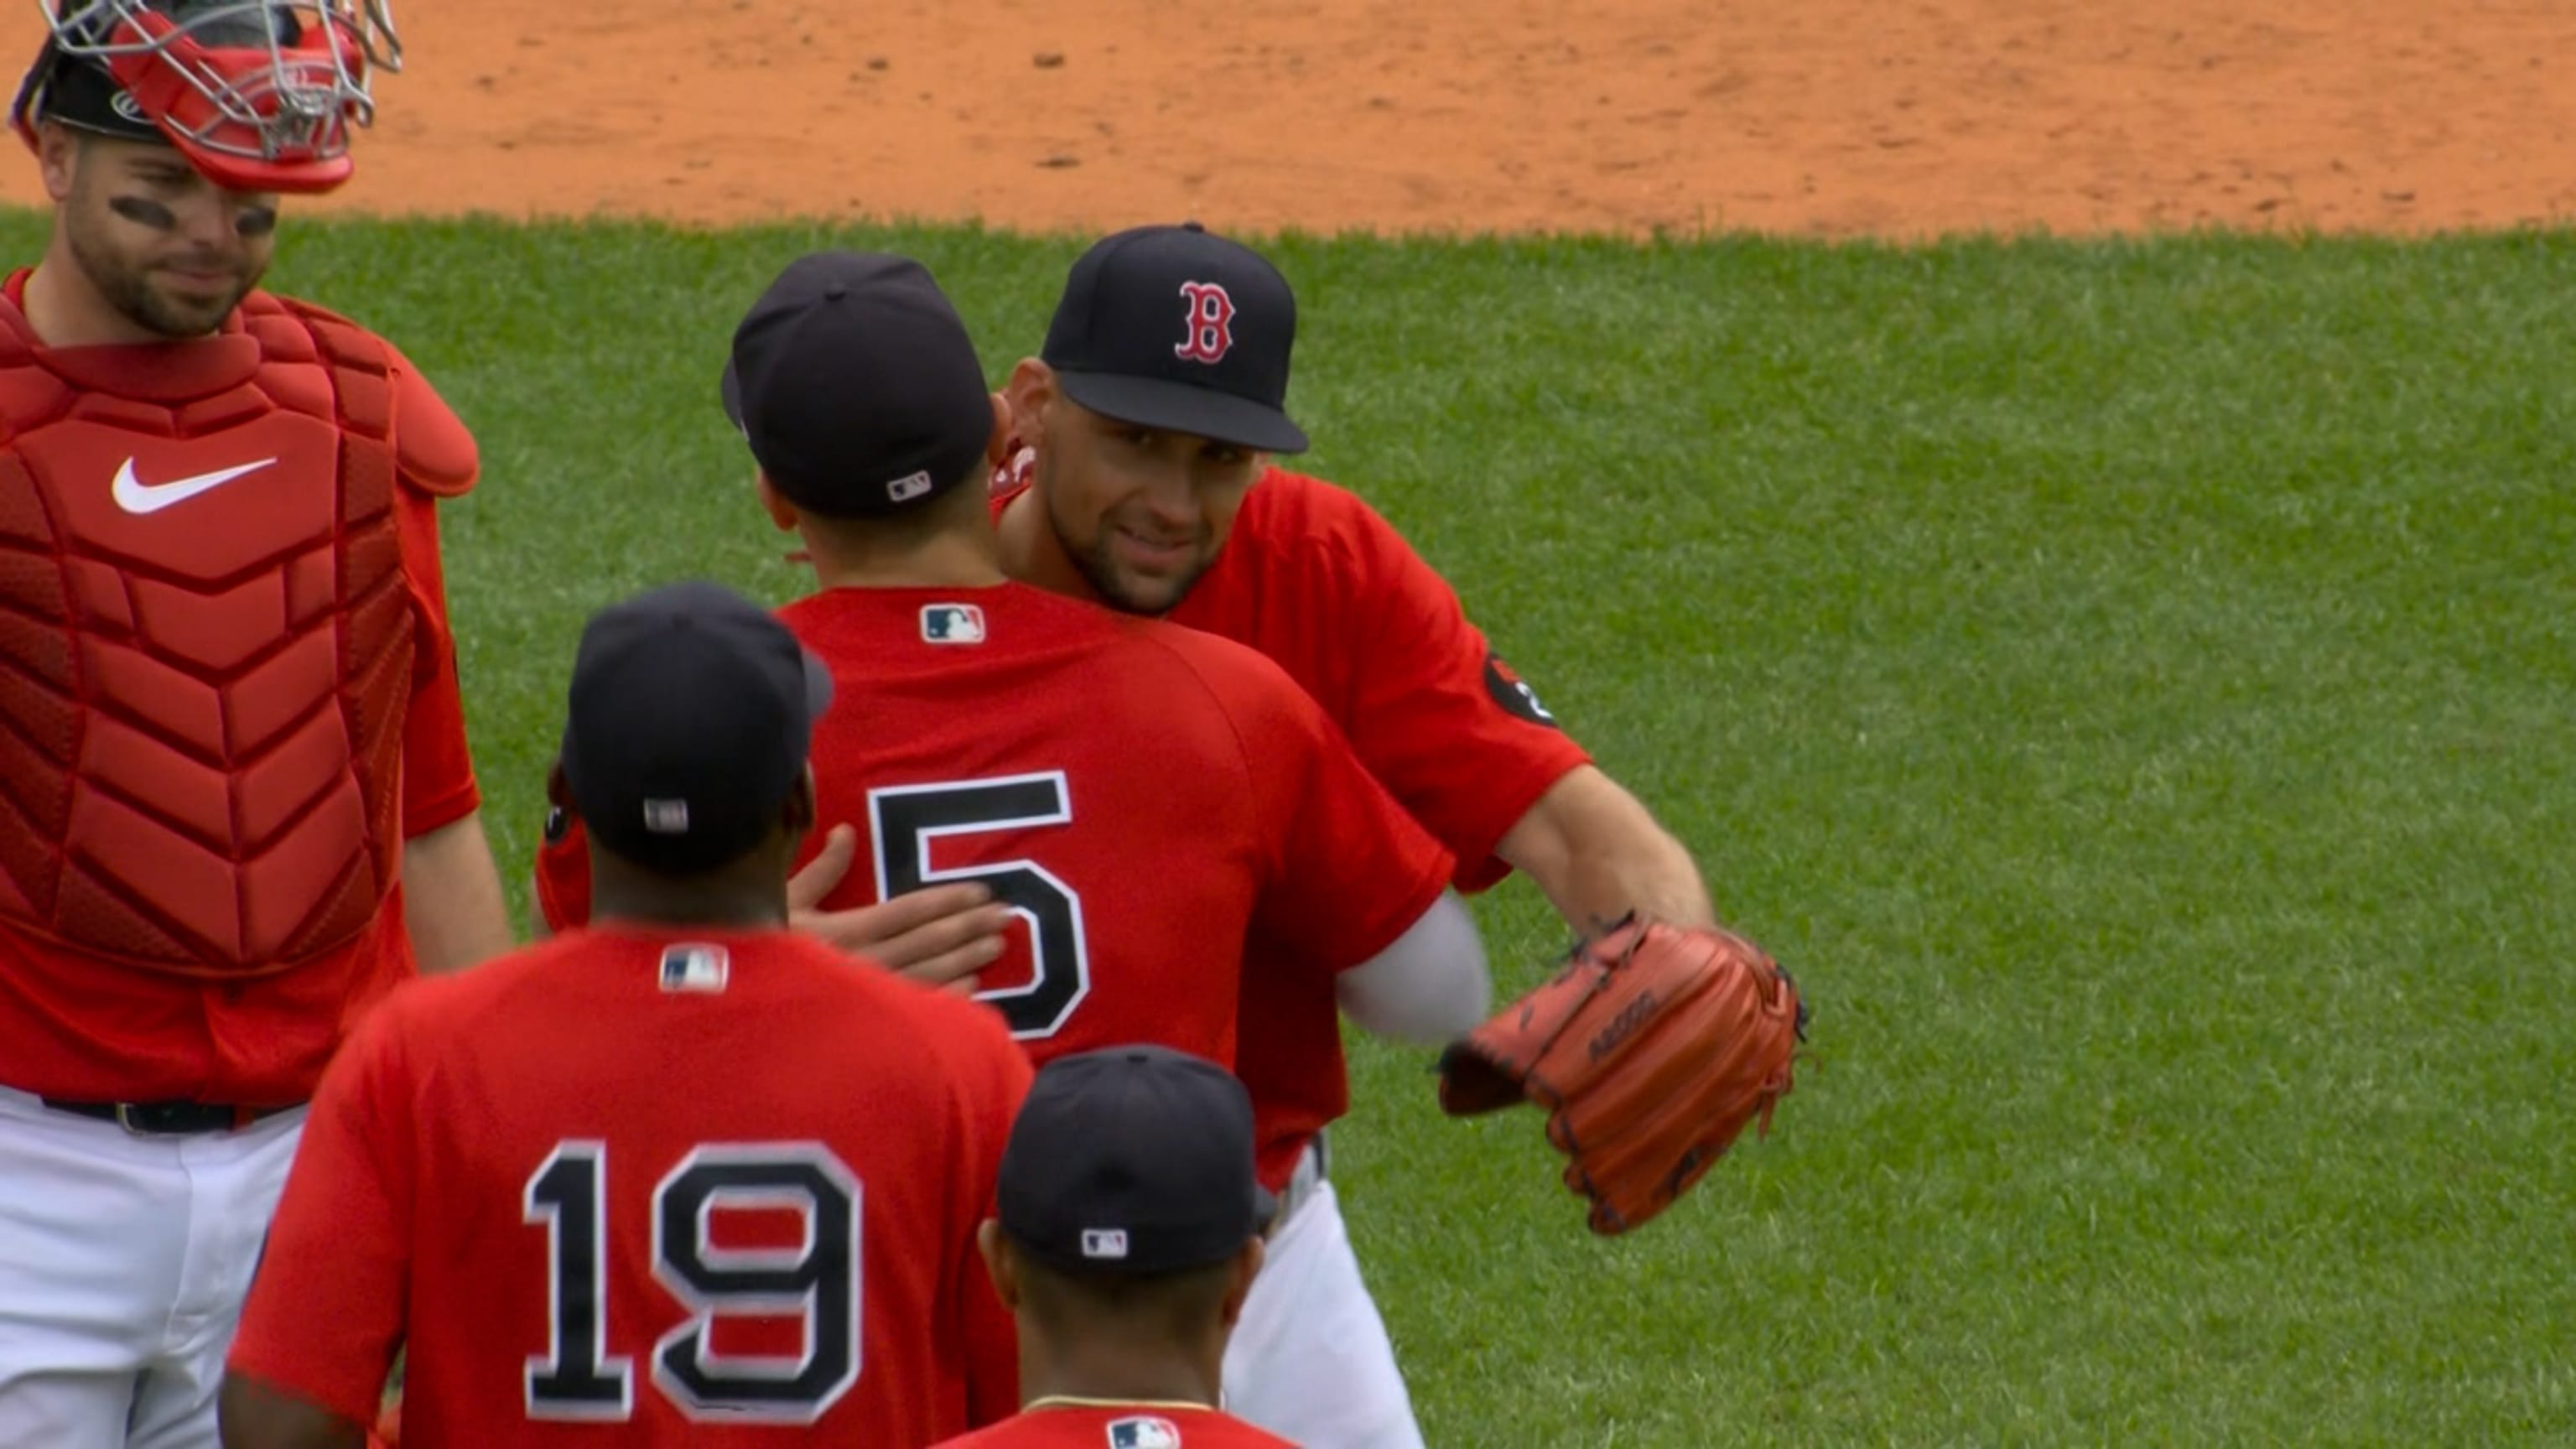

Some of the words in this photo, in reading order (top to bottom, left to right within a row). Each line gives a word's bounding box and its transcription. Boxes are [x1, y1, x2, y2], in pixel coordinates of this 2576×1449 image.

[1175, 280, 1236, 364] B
[866, 769, 1091, 1041] 5
[523, 1139, 863, 1424] 19
